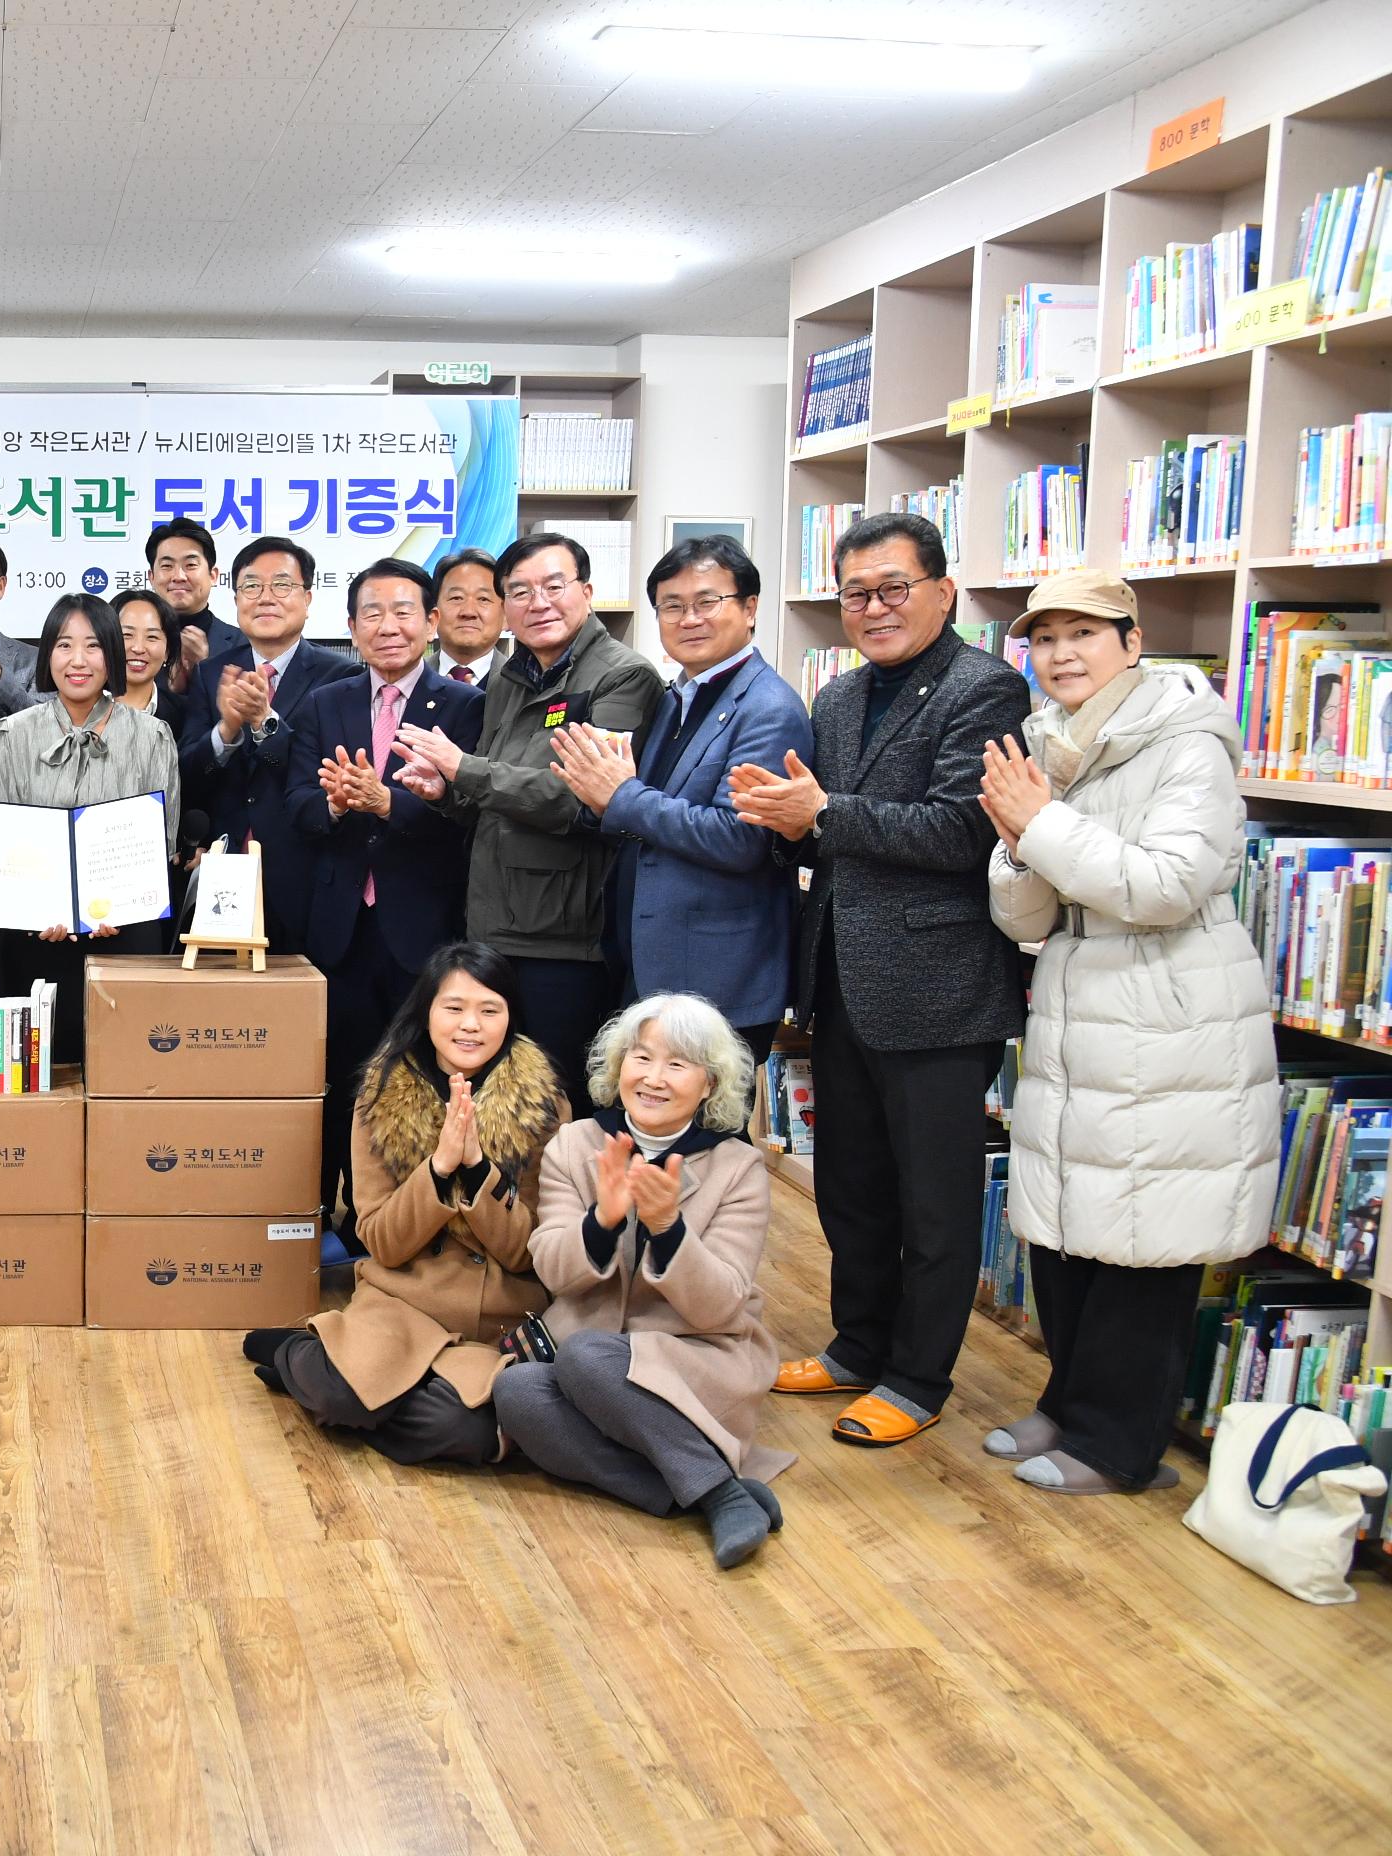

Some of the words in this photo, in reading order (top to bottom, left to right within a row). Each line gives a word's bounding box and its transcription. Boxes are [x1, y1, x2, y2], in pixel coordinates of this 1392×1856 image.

[1159, 129, 1183, 151] 800
[1190, 117, 1210, 140] 문학
[1269, 300, 1293, 323] 문학
[428, 362, 488, 384] 어린이
[30, 431, 131, 452] 작은도서관
[138, 431, 147, 453] /
[155, 432, 314, 453] 뉴시티에일린의뜰
[322, 433, 351, 454] 1차
[359, 433, 457, 454] 작은도서관
[152, 478, 263, 534] 도서
[288, 478, 455, 534] 기증식
[16, 572, 66, 588] 13:00
[84, 575, 106, 587] 장소
[186, 1028, 268, 1042] 국회도서관
[184, 1148, 264, 1162] 국회도서관
[183, 1263, 263, 1276] 국회도서관
